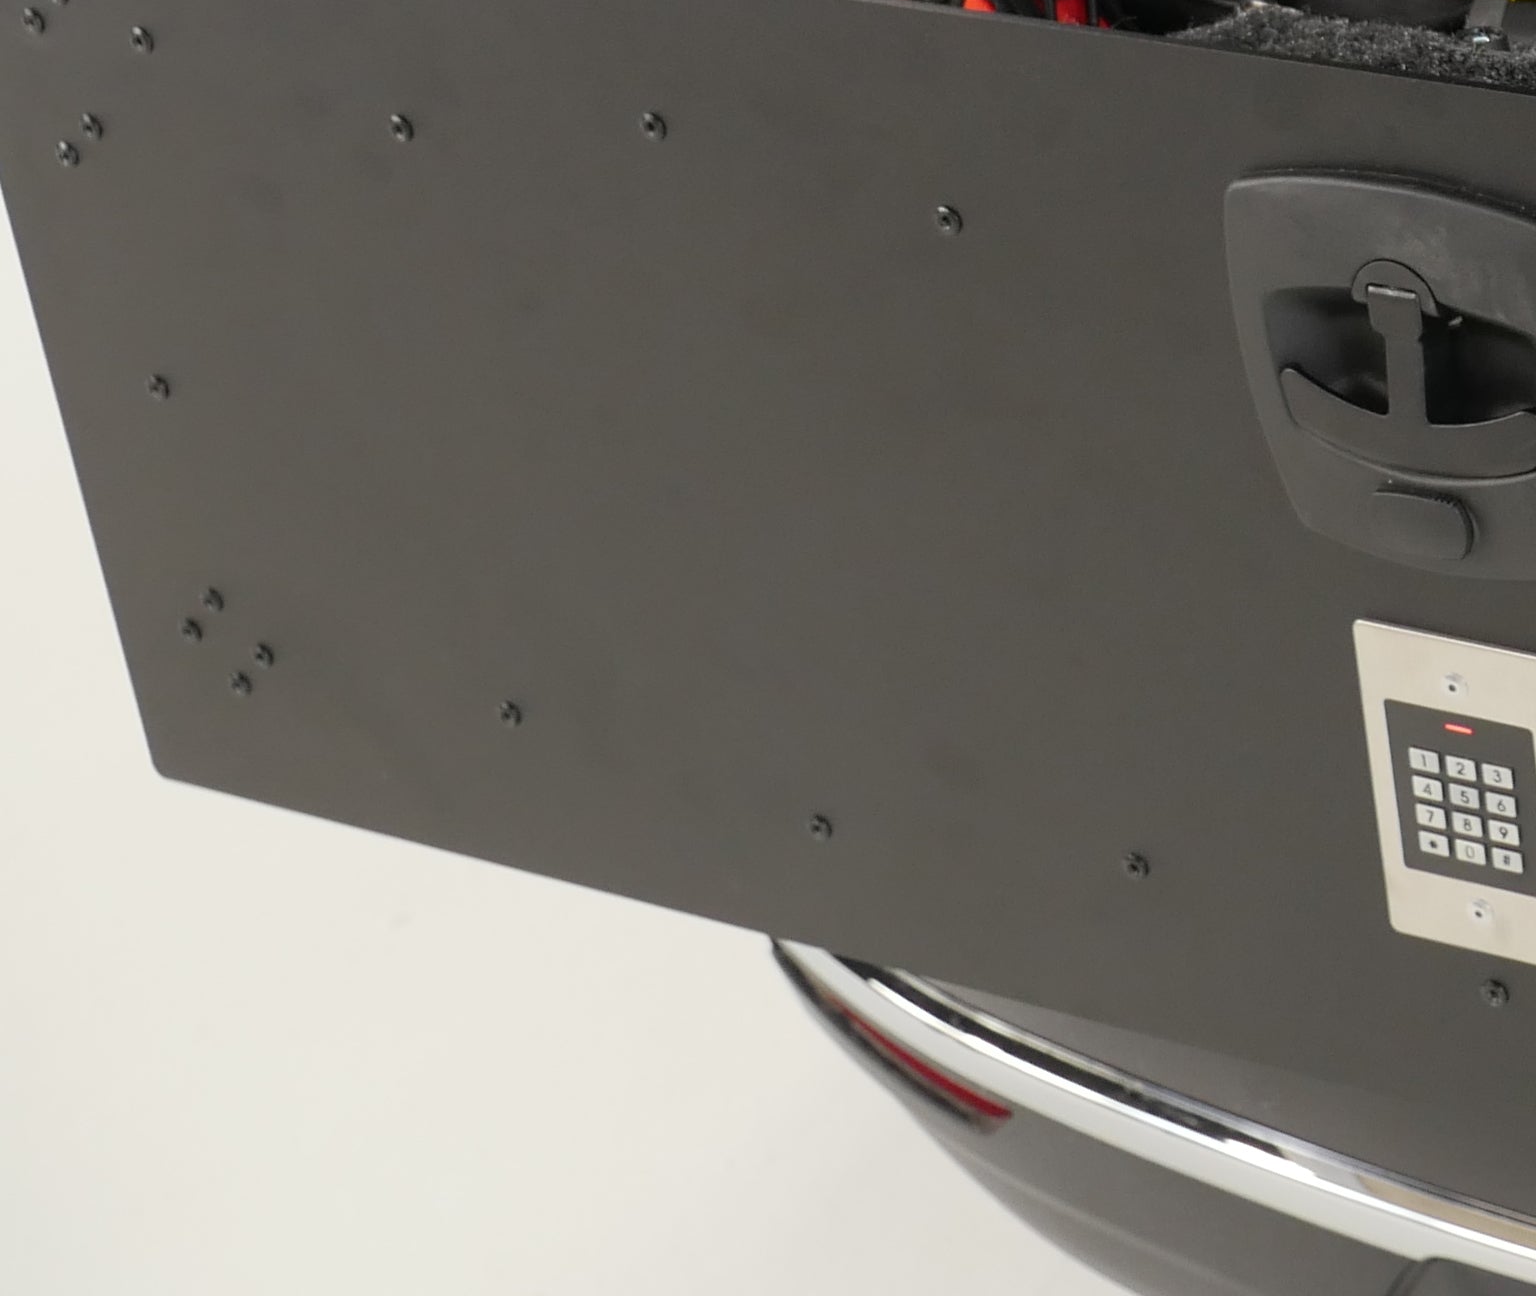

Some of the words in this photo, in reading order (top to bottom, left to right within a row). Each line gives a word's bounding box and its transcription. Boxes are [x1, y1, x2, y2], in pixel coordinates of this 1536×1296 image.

[1455, 762, 1465, 776] 2
[1493, 770, 1502, 783] 3
[1423, 783, 1432, 796] 4
[1460, 790, 1469, 804] 5
[1497, 800, 1506, 812] 6
[1425, 809, 1434, 823] 7
[1463, 818, 1472, 832] 8
[1499, 827, 1508, 839] 9
